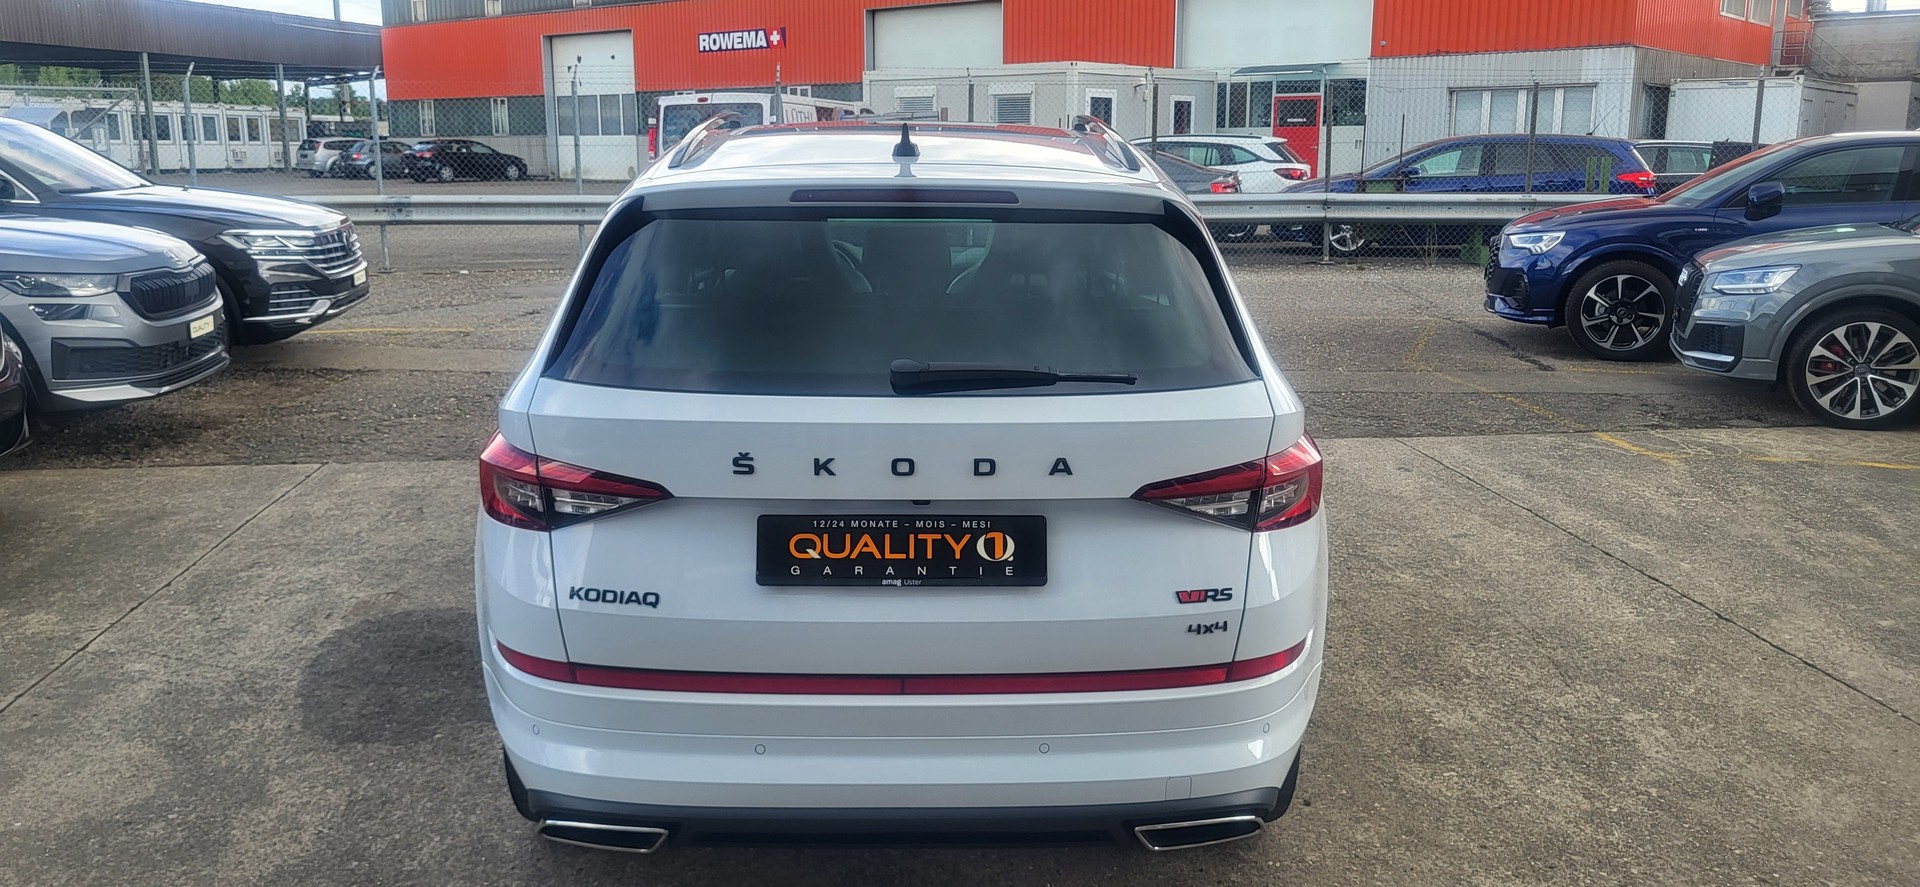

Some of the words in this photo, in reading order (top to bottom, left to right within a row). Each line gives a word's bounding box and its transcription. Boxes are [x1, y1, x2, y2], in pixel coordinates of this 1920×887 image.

[699, 30, 768, 51] ROWEMA
[732, 452, 1073, 477] ŠKODA
[812, 520, 845, 528] 12/24
[850, 520, 899, 528] MONATE
[915, 520, 946, 529] MOIS
[962, 520, 991, 529] MESI
[789, 533, 972, 559] QUALITY
[790, 565, 1014, 576] GARANTIE
[881, 579, 902, 587] amag
[569, 586, 660, 608] KODIAQ
[1187, 620, 1228, 635] 4x4
